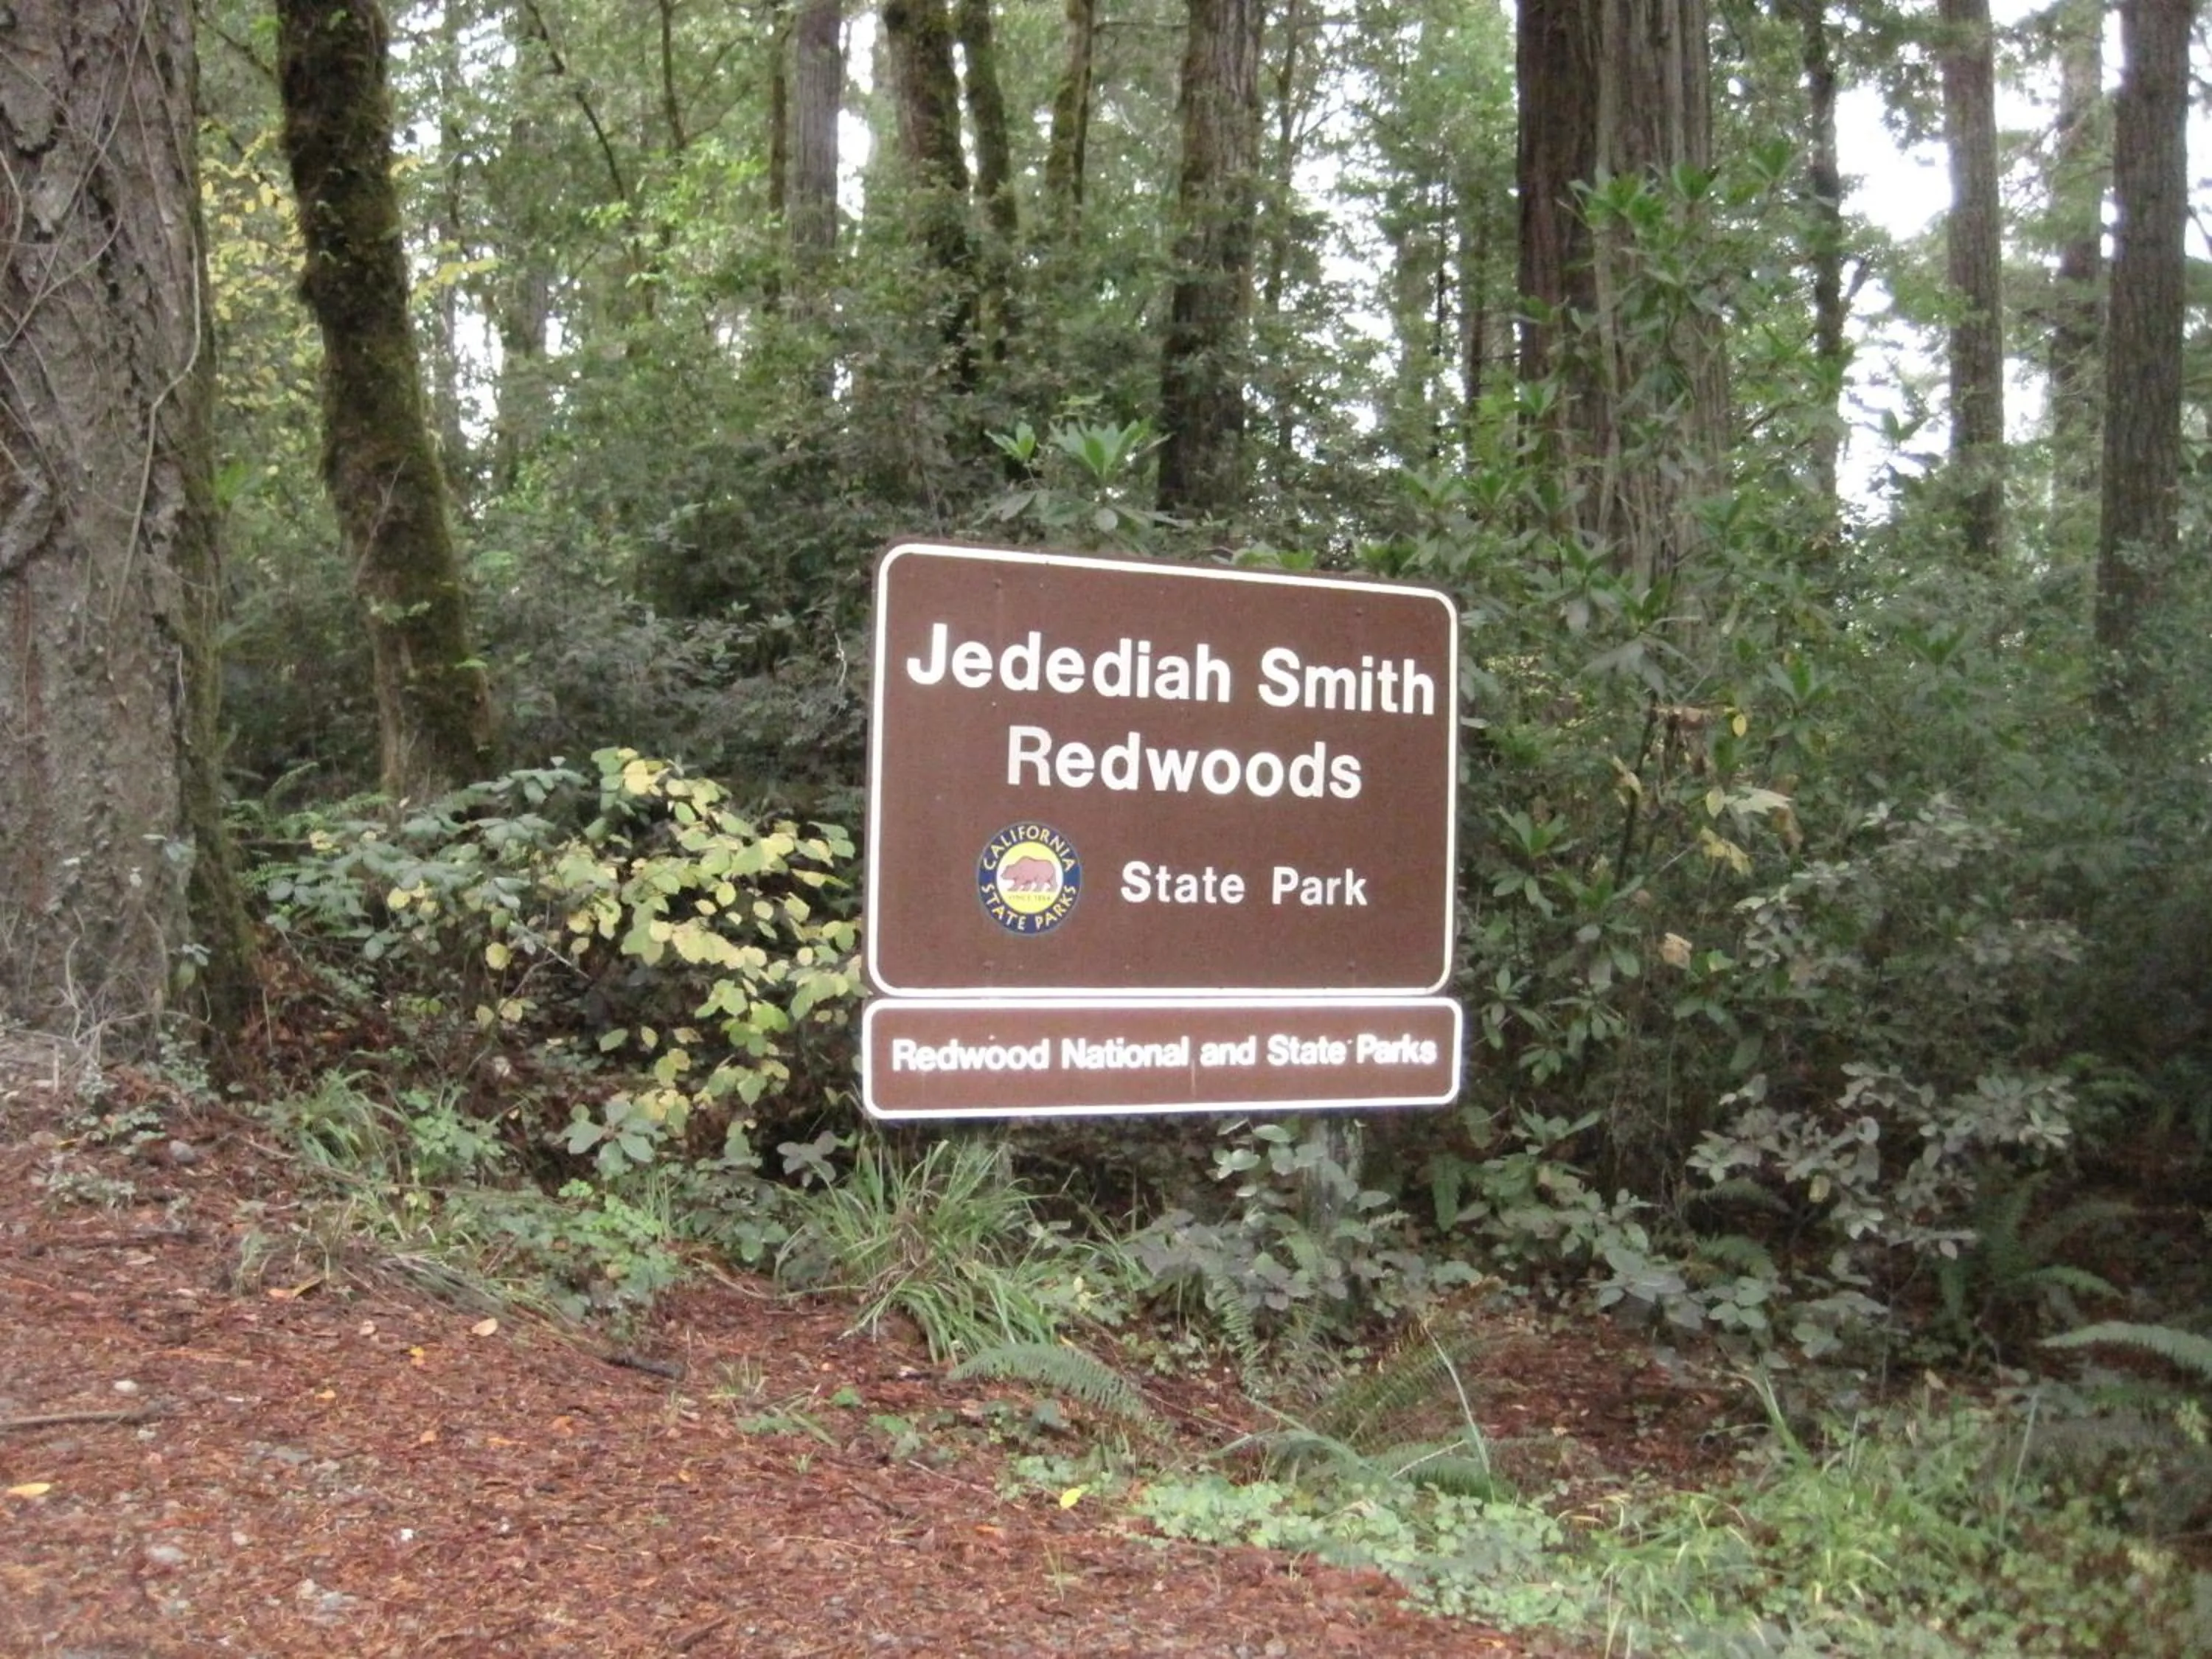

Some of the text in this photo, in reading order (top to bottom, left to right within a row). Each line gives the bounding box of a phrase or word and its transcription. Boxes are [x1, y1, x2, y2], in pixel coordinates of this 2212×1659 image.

[905, 622, 1436, 715] Jedediah Smith
[1007, 725, 1363, 799] Redwoods
[983, 824, 1076, 872] CALIFORNIA
[981, 883, 1077, 931] STATE PARKS
[1120, 860, 1368, 906] State Park
[891, 1032, 1438, 1071] Redwood National and State Parks
